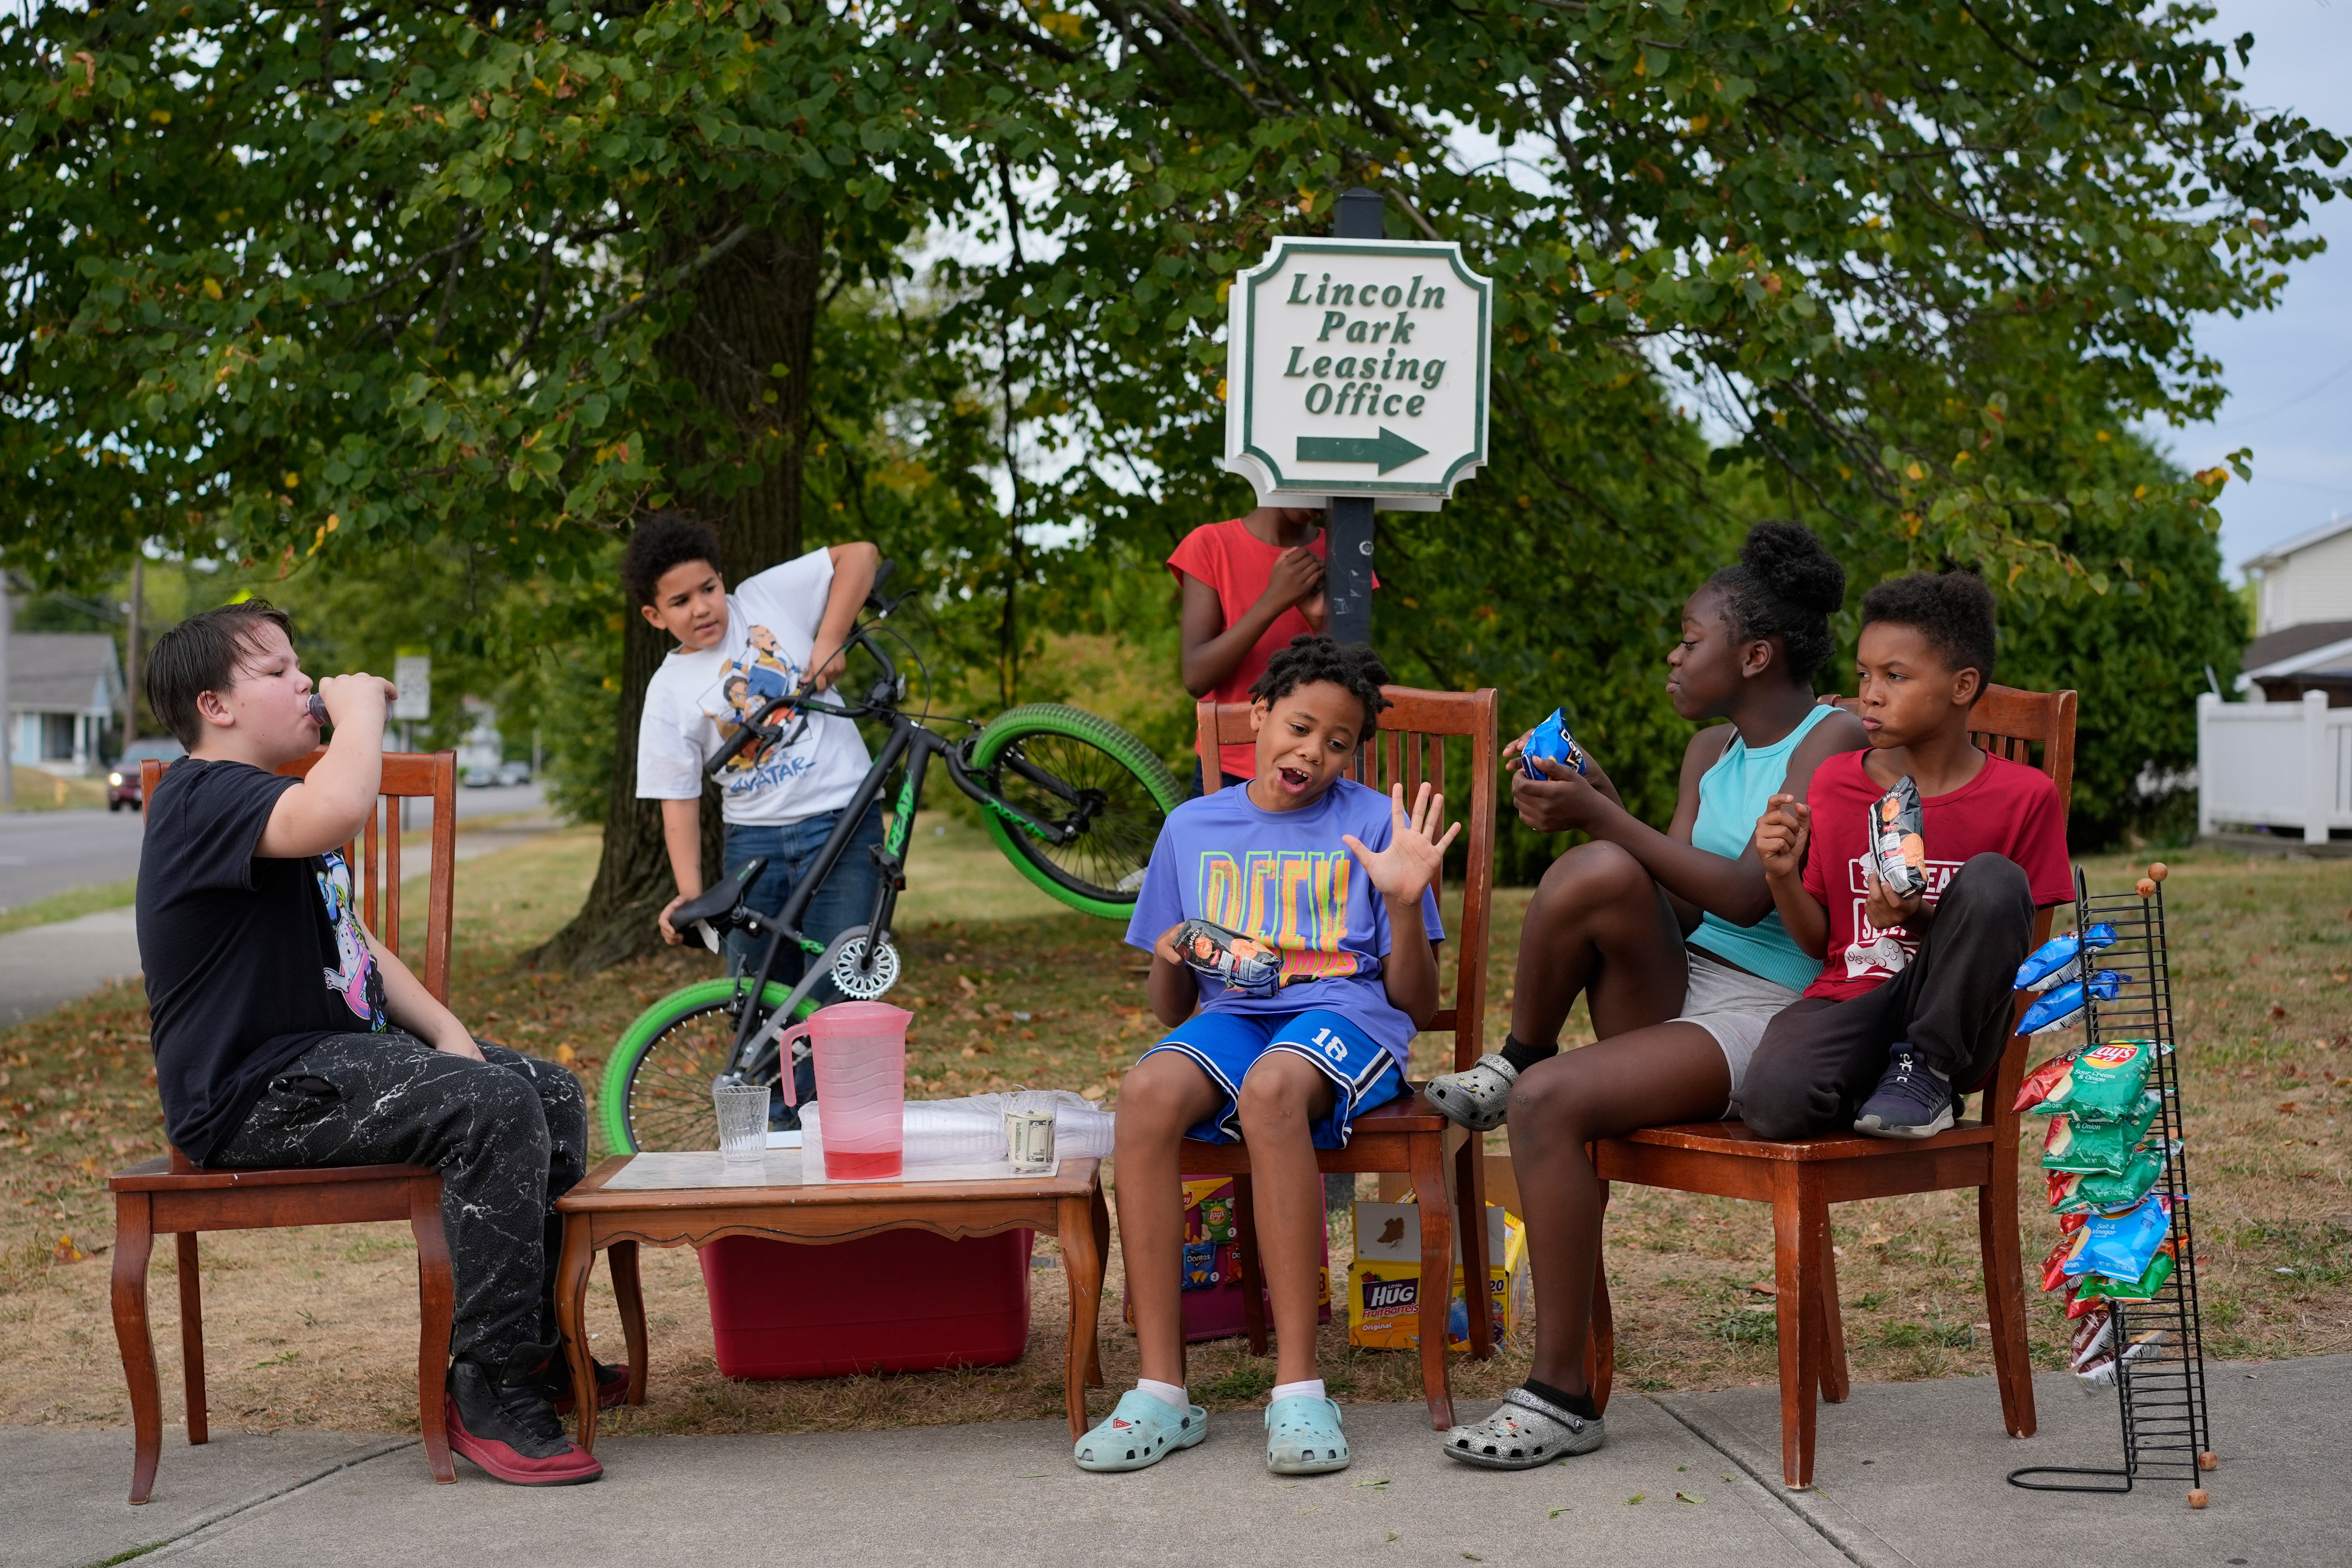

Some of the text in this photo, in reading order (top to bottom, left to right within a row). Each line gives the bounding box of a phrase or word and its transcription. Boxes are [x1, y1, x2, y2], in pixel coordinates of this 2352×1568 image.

[1287, 273, 1445, 308] Lincoln
[1317, 311, 1415, 344] Park
[1283, 346, 1447, 390] Leasing
[1305, 382, 1426, 417] Office
[730, 756, 816, 793] AVATAR
[1883, 791, 1903, 802] SMOKY
[1926, 867, 1960, 894] EA
[1189, 930, 1200, 950] SMOKY
[1311, 1028, 1348, 1062] 18
[2086, 1046, 2135, 1062] Lay's
[2084, 1074, 2106, 1083] Onion
[2092, 1070, 2116, 1079] Cream
[1209, 1210, 1225, 1220] Lay's
[2092, 1228, 2116, 1236] Vinegar
[1187, 1253, 1211, 1263] Doritos
[1370, 1286, 1415, 1307] HUG
[1362, 1302, 1420, 1320] Fruit Barrels
[1362, 1322, 1392, 1331] Original
